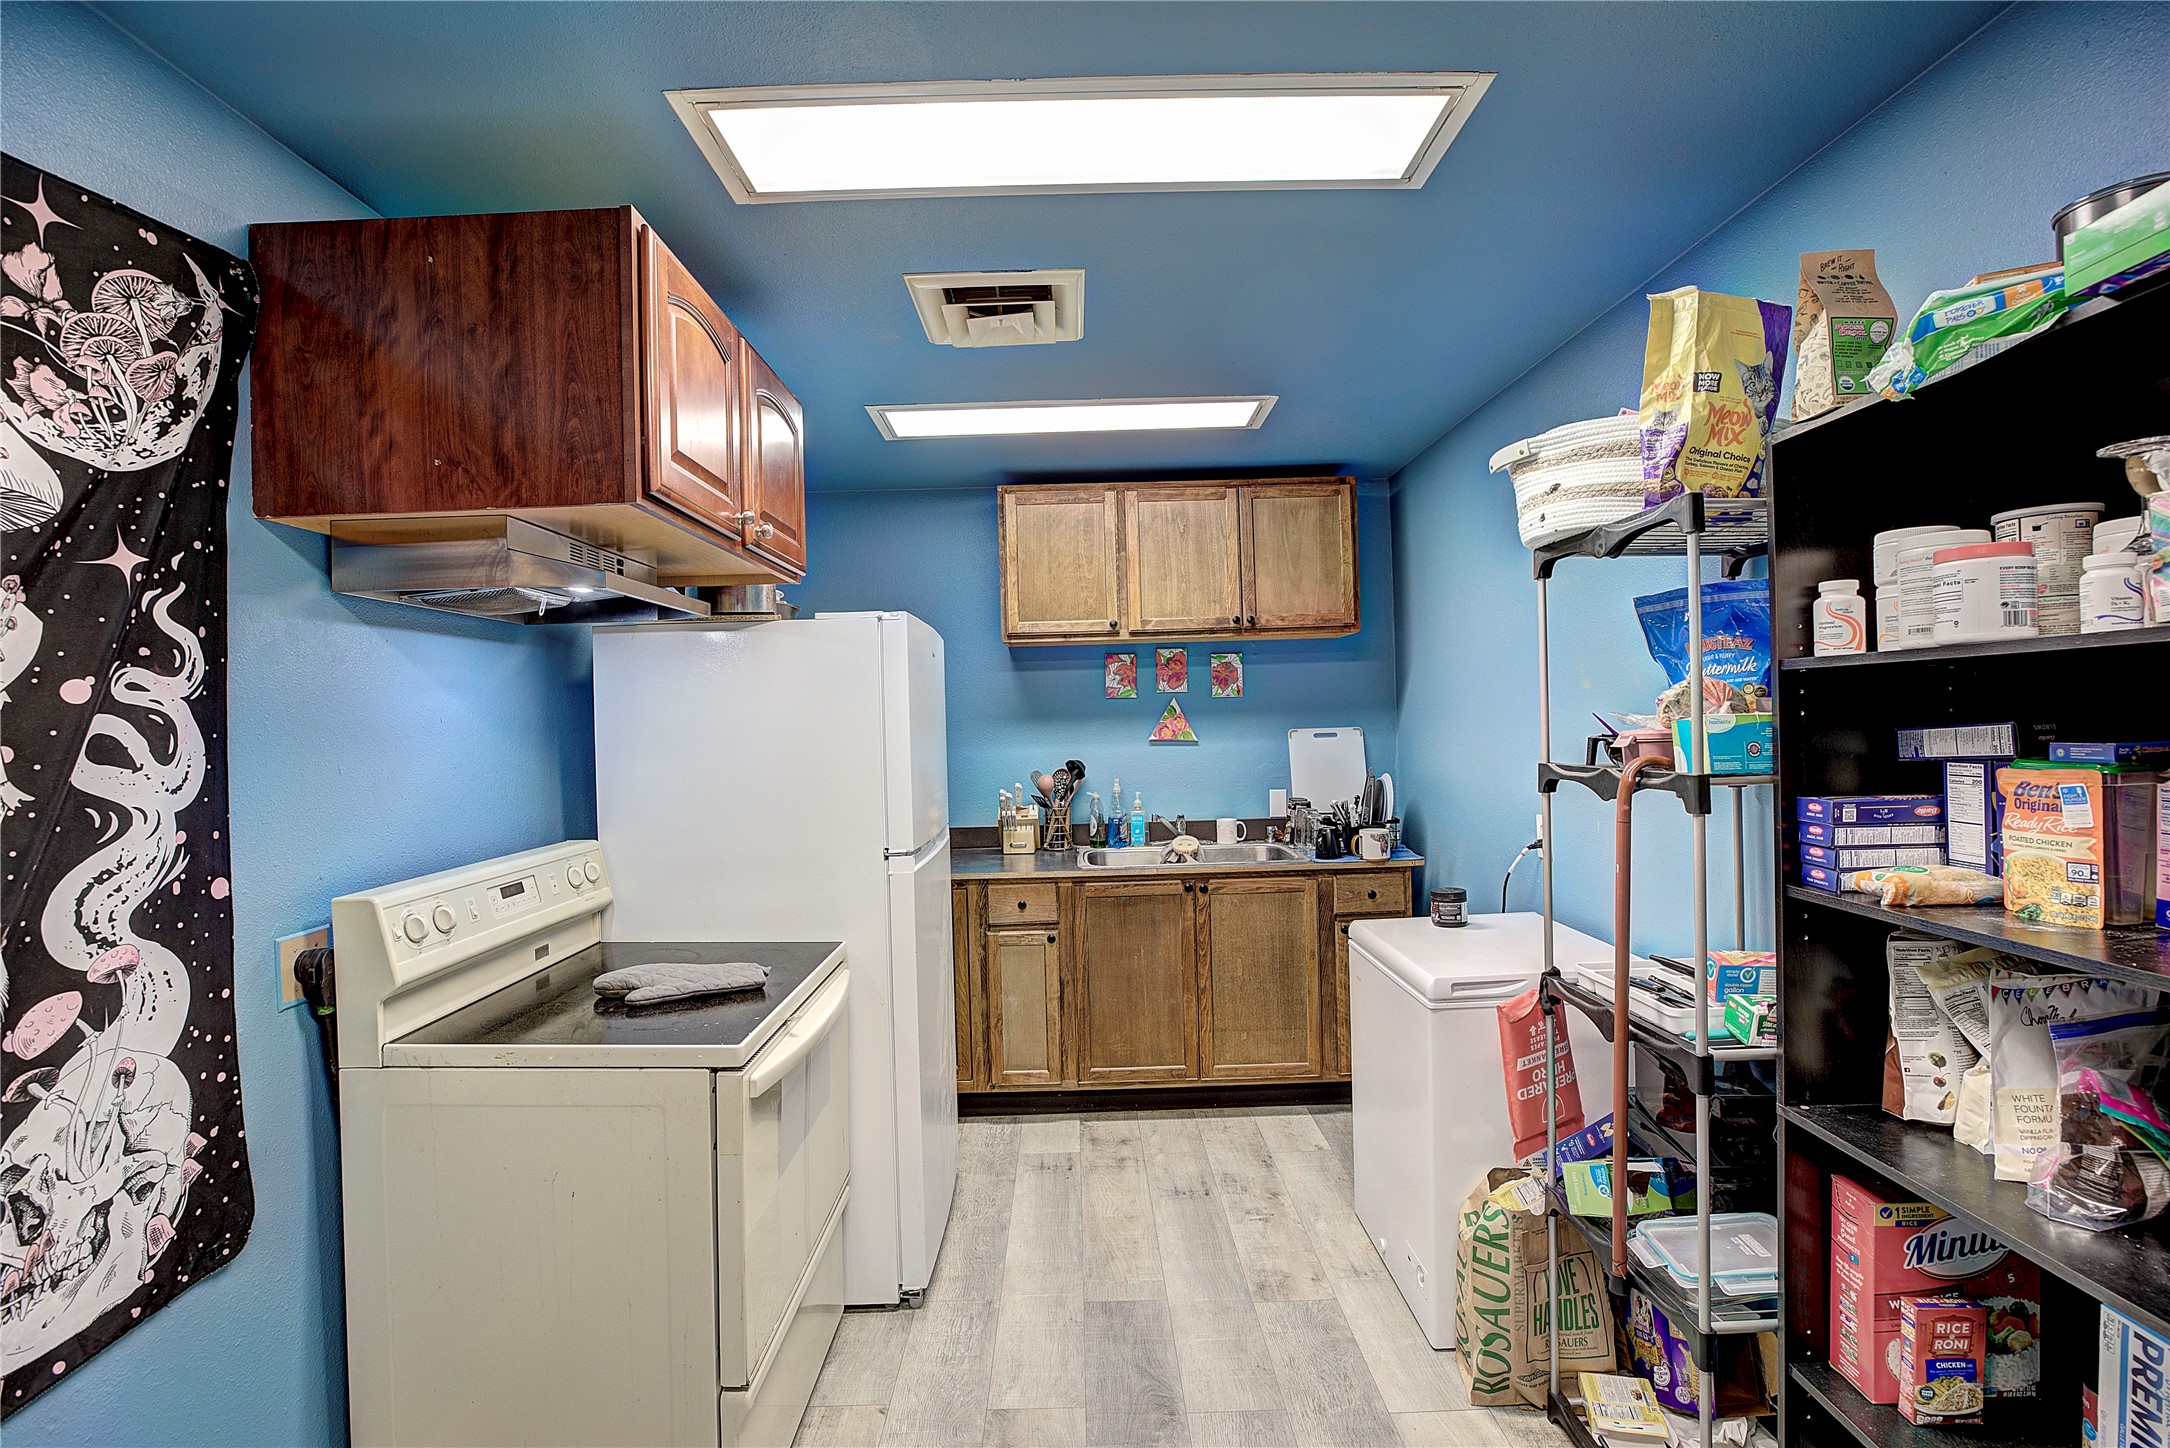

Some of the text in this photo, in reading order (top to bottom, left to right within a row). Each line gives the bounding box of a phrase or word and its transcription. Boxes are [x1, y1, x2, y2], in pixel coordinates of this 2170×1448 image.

[1820, 257, 1836, 273] BREW
[1838, 262, 1855, 273] RIGHT
[1944, 299, 1985, 318] FOREVER
[1946, 313, 1966, 325] PALS
[1689, 446, 1751, 464] Original Choice
[1943, 580, 1961, 588] Facts
[1685, 636, 1754, 657] USTEAZ
[1686, 656, 1758, 676] uttermilk
[2013, 780, 2062, 799] Ben's
[2013, 797, 2063, 814] Original
[2004, 812, 2043, 834] Ready
[2008, 834, 2073, 848] ROASTED CHICKEN
[2070, 869, 2084, 877] 90
[1532, 1060, 1566, 1082] HRO
[2011, 1094, 2046, 1103] WHITE
[1573, 1182, 1582, 1207] kitchen
[1894, 1206, 1931, 1219] 1 SIMPLE
[1906, 1230, 2008, 1267] Minu
[1512, 1216, 1526, 1332] SUPERMARKETS
[2008, 1274, 2016, 1283] 5
[1472, 1201, 1512, 1395] ROSAUERS
[1936, 1323, 1970, 1334] RICE
[1545, 1336, 1589, 1349] RSAUERS
[1934, 1339, 1969, 1350] RONI
[1935, 1361, 1967, 1369] CHICKEN
